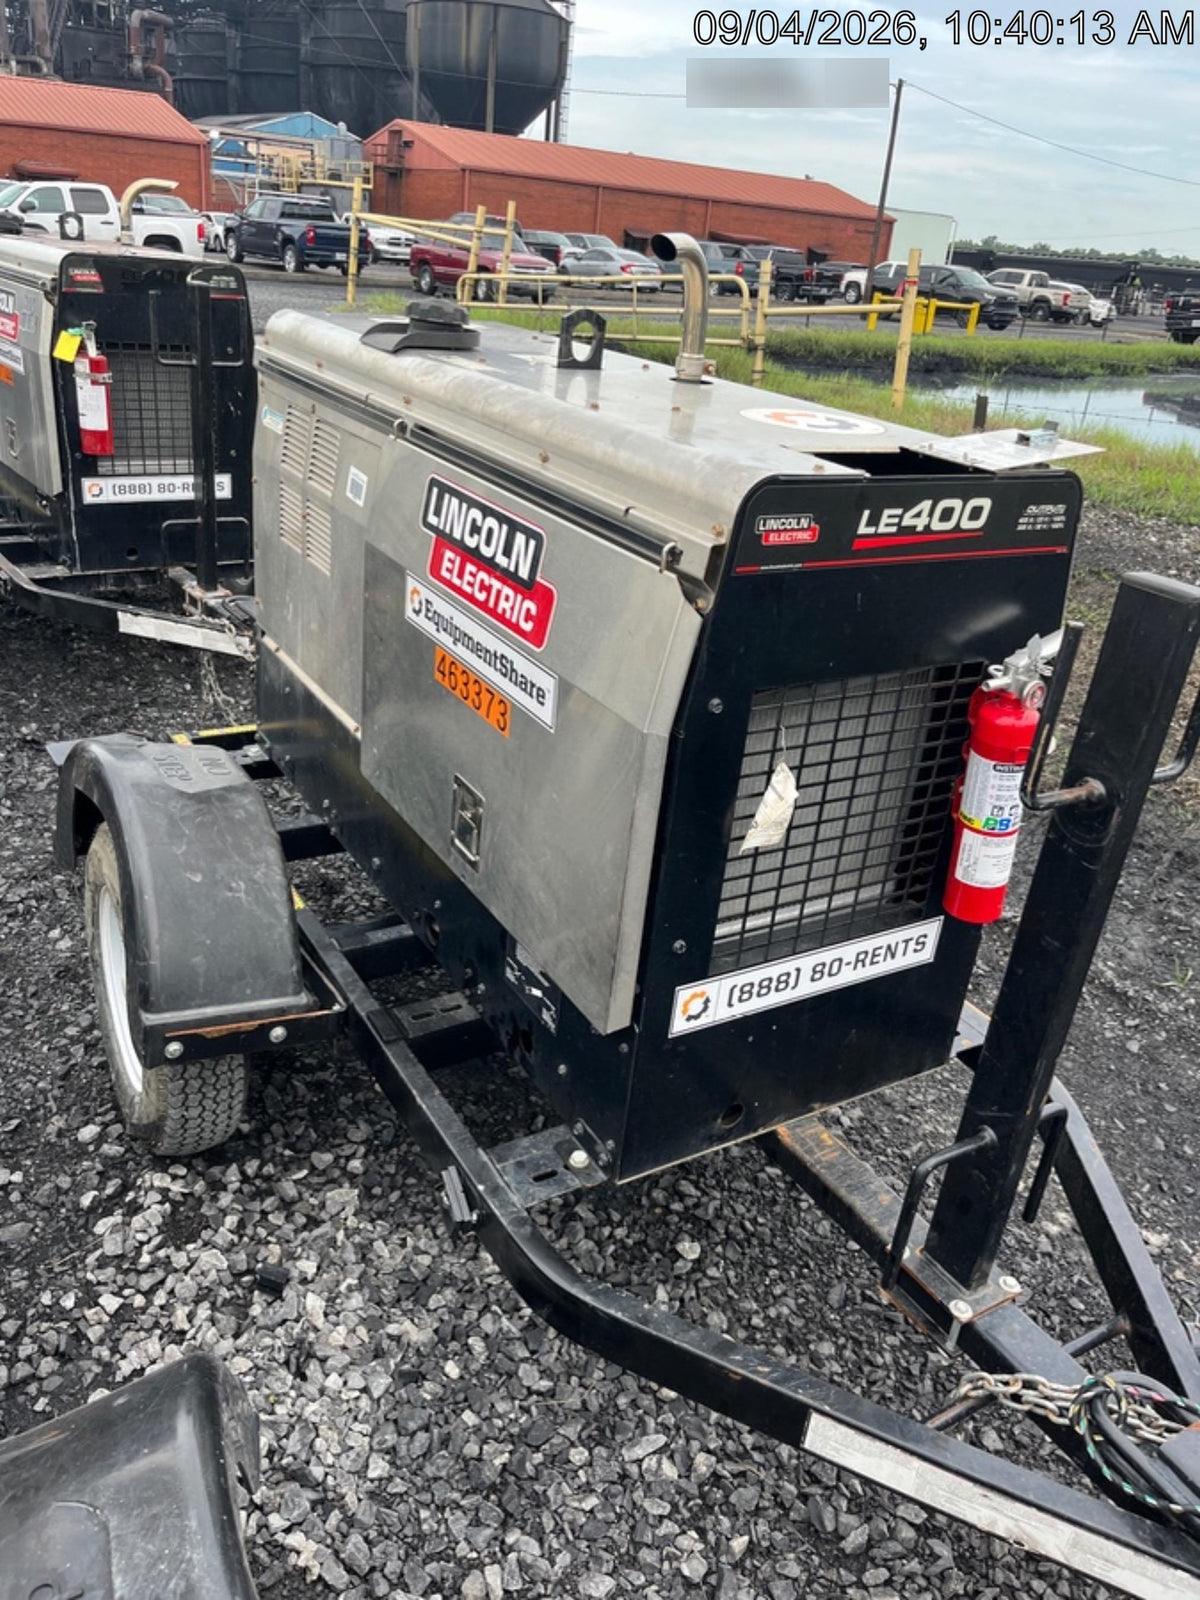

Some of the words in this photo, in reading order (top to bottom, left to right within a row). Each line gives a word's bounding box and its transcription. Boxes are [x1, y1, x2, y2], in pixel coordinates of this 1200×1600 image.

[112, 483, 152, 496] (888)
[759, 516, 810, 530] LINCOLN
[856, 497, 993, 535] LE400
[426, 486, 537, 581] LINCOLN
[769, 530, 813, 541] ELECTRIC
[440, 549, 538, 632] ELECTRIC
[424, 598, 547, 707] EquipmentShare
[436, 653, 509, 733] 463373
[726, 968, 802, 1009] (888)
[810, 934, 929, 982] 80-RENTS
